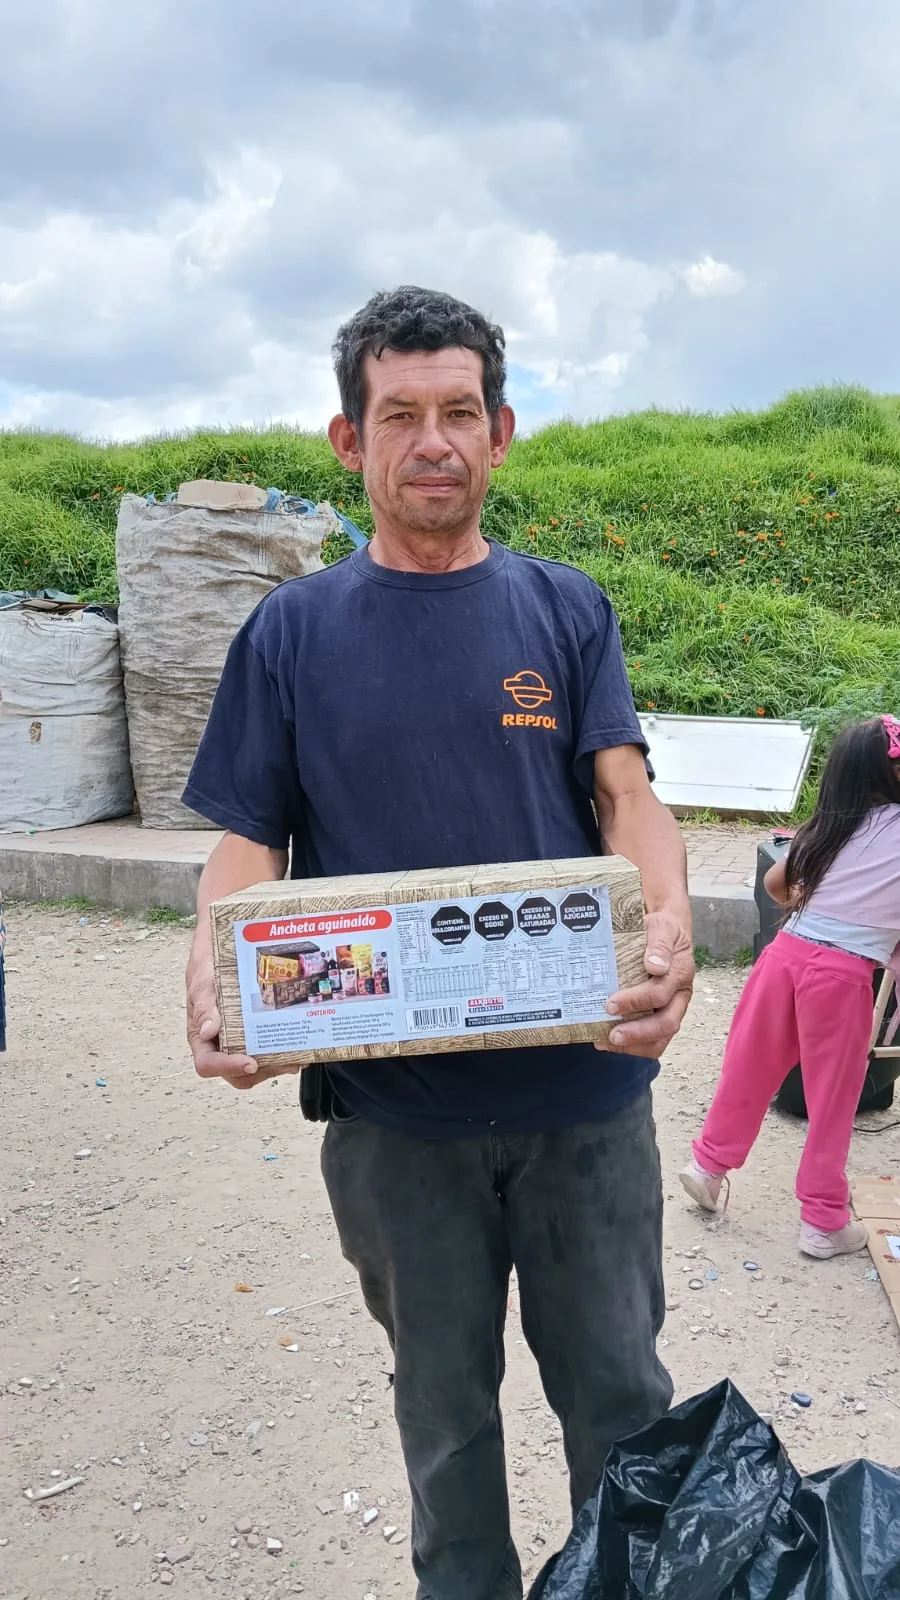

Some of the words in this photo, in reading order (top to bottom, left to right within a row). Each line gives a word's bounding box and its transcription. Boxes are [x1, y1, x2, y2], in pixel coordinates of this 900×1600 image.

[502, 713, 557, 730] REPSOL
[521, 907, 543, 915] EXCESO
[564, 906, 586, 914] EXCESO
[478, 914, 500, 923] EXCESO
[523, 912, 550, 921] GRASAS
[269, 921, 316, 937] Ancheta
[317, 914, 377, 933] aguinaldo
[436, 918, 464, 927] CONTIENE
[484, 920, 504, 929] SODIO
[519, 918, 556, 928] SATURADAS
[306, 1008, 336, 1018] CONTENIDO
